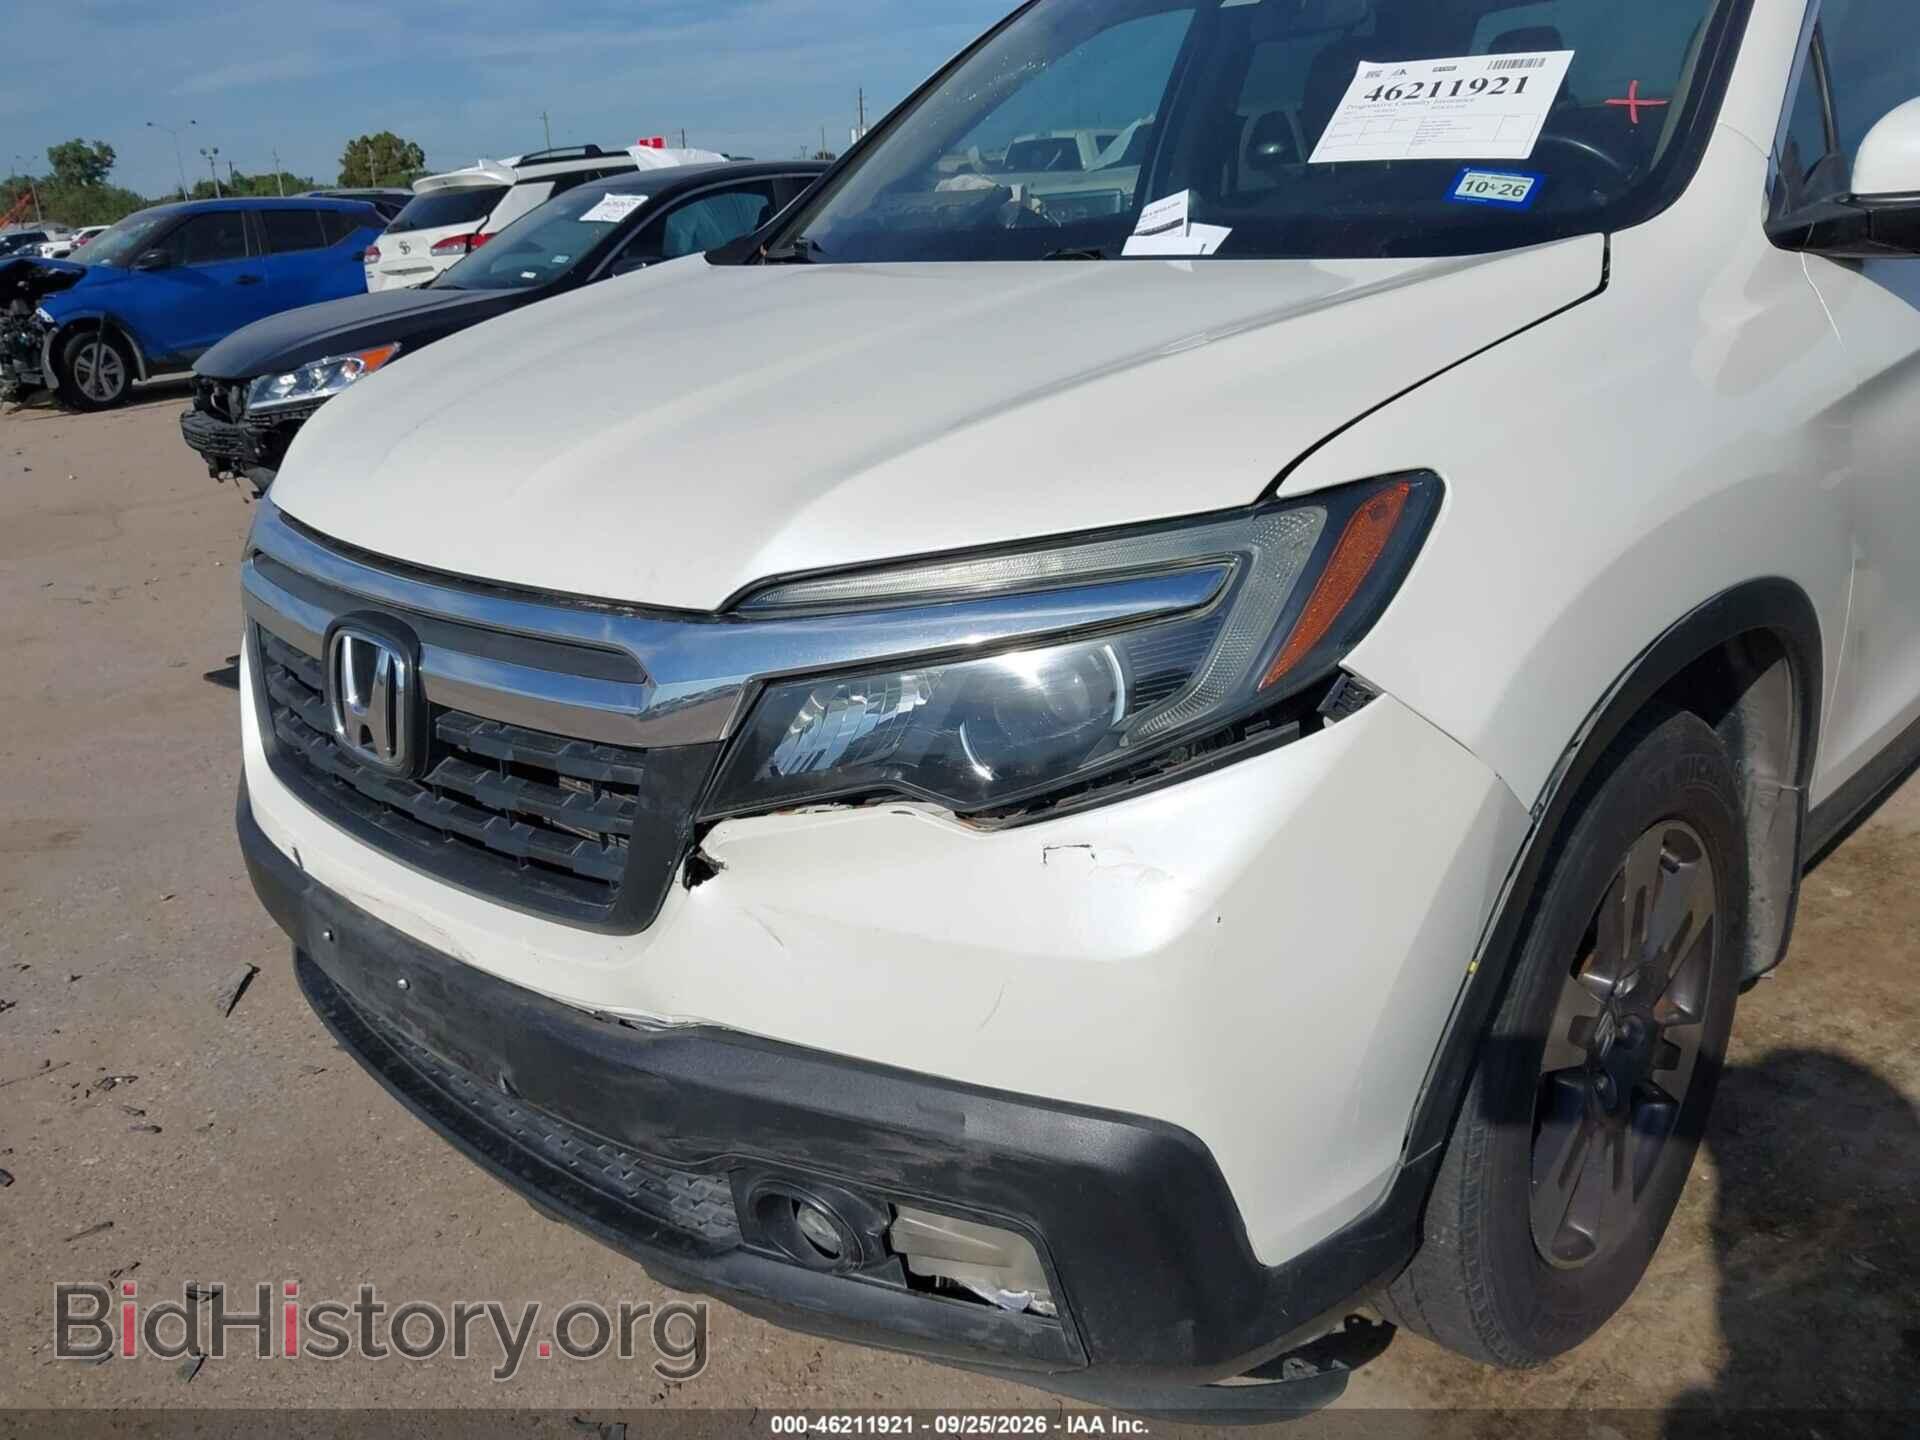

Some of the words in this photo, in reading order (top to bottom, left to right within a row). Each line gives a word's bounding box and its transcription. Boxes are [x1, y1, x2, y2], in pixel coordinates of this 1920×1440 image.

[1364, 76, 1529, 102] 46211921
[1465, 180, 1489, 193] 10
[1497, 183, 1526, 197] 26
